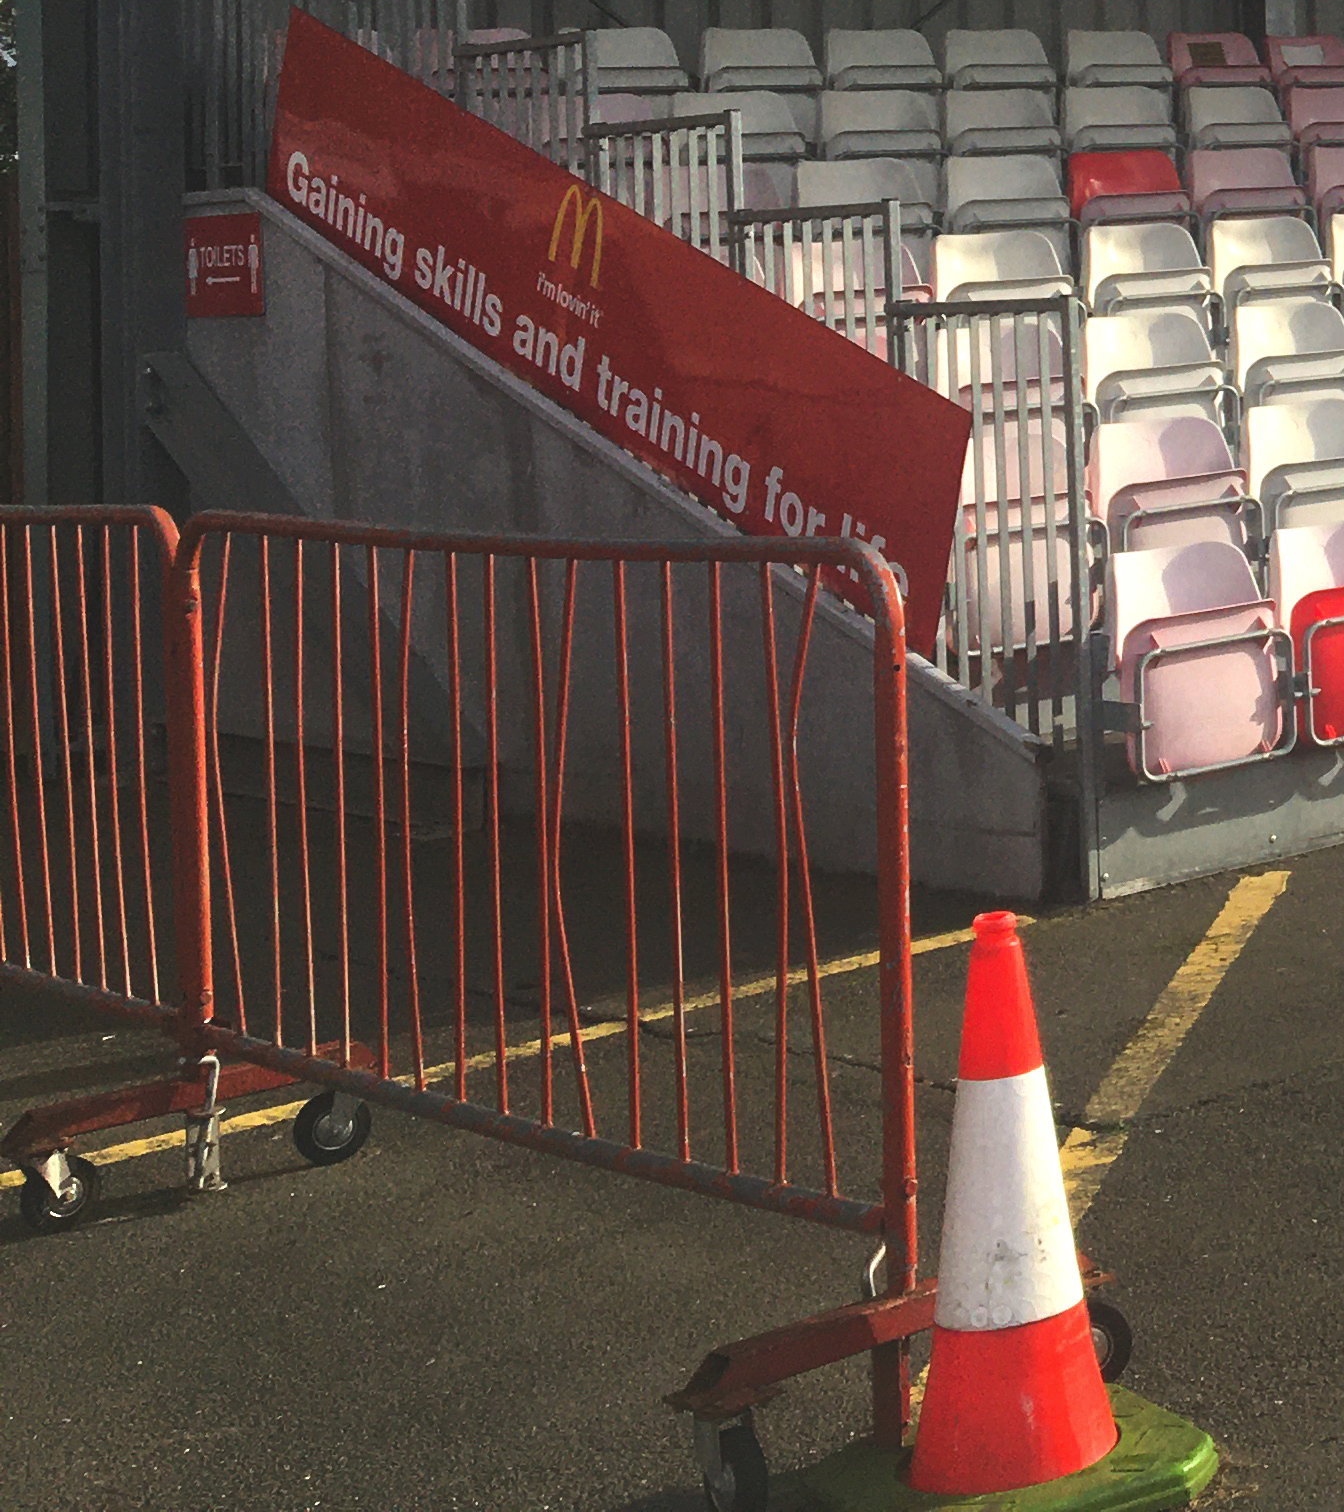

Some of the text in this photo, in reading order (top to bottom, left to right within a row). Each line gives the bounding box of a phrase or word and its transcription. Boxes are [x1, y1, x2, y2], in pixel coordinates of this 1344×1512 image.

[199, 244, 246, 268] TOILETS
[286, 150, 405, 281] Gaining
[414, 244, 503, 337] skills
[512, 314, 586, 392] and
[596, 354, 751, 514] training
[764, 465, 826, 538] for
